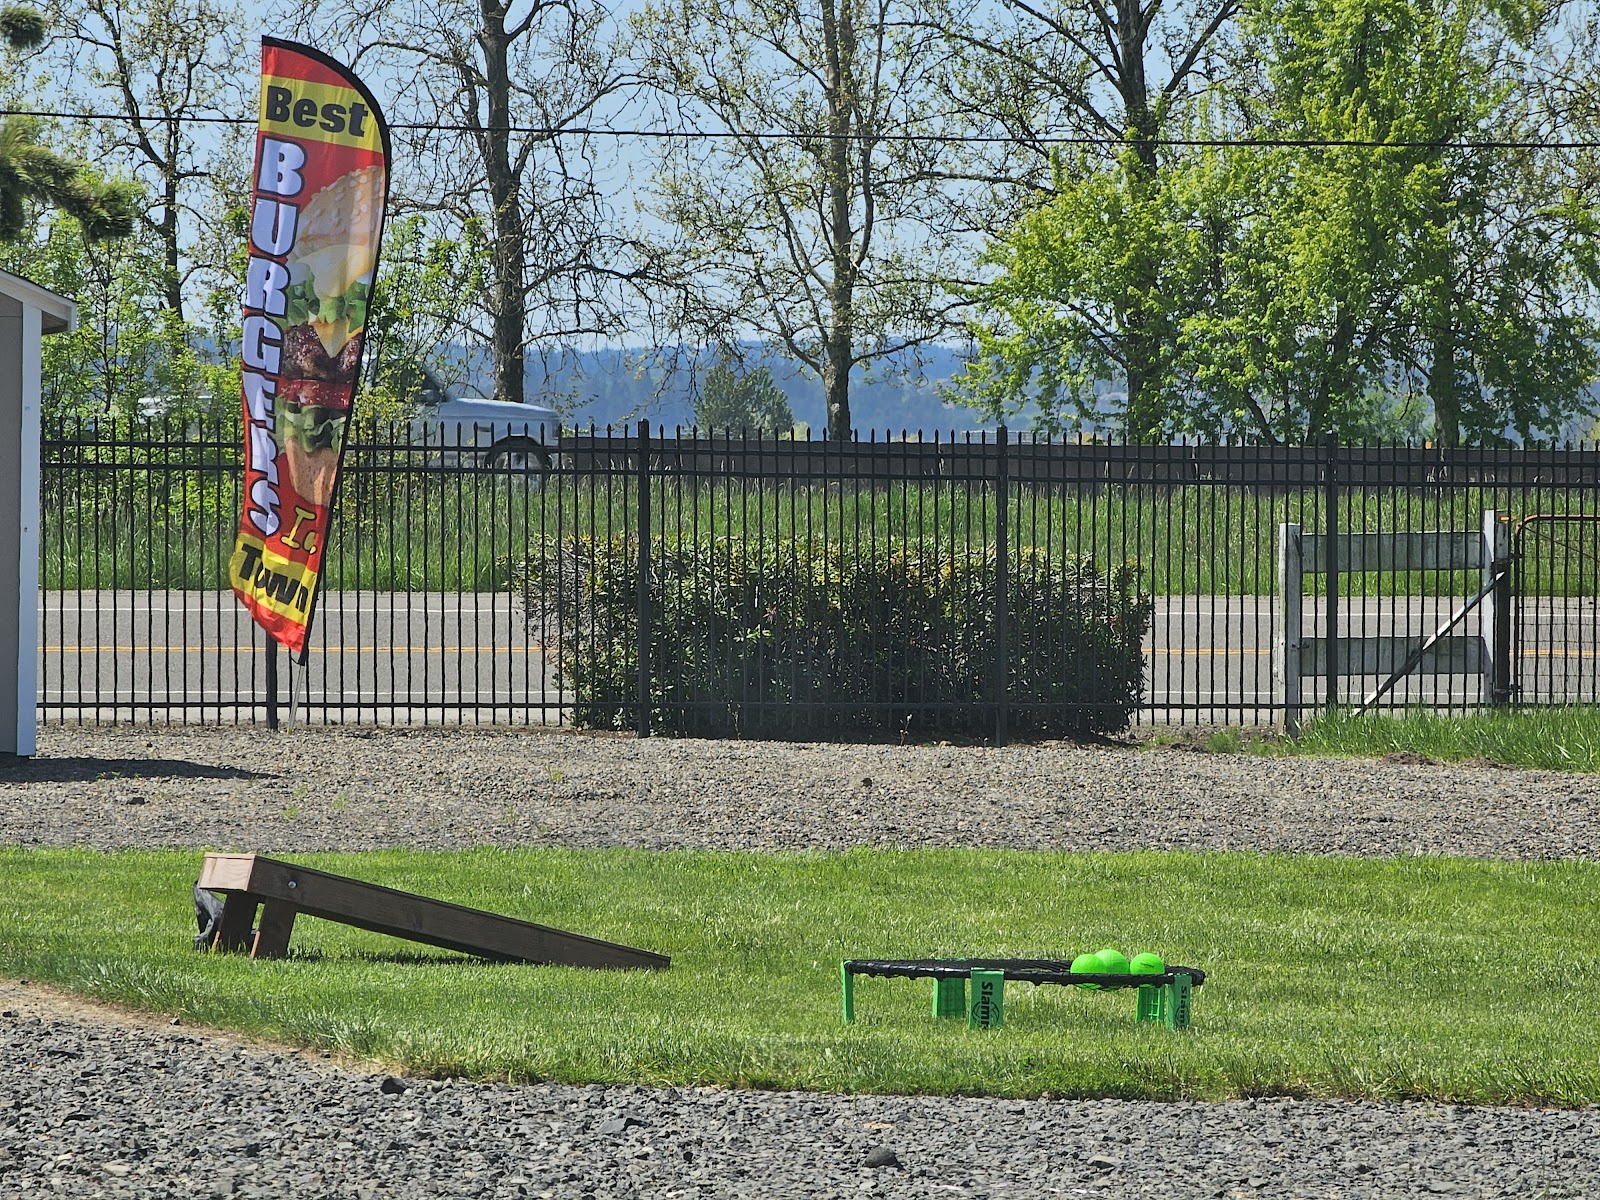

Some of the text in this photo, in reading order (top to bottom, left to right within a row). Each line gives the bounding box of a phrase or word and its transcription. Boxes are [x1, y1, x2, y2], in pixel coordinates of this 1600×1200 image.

[265, 85, 369, 138] Best
[241, 136, 308, 536] BURGERS
[238, 543, 309, 614] Town
